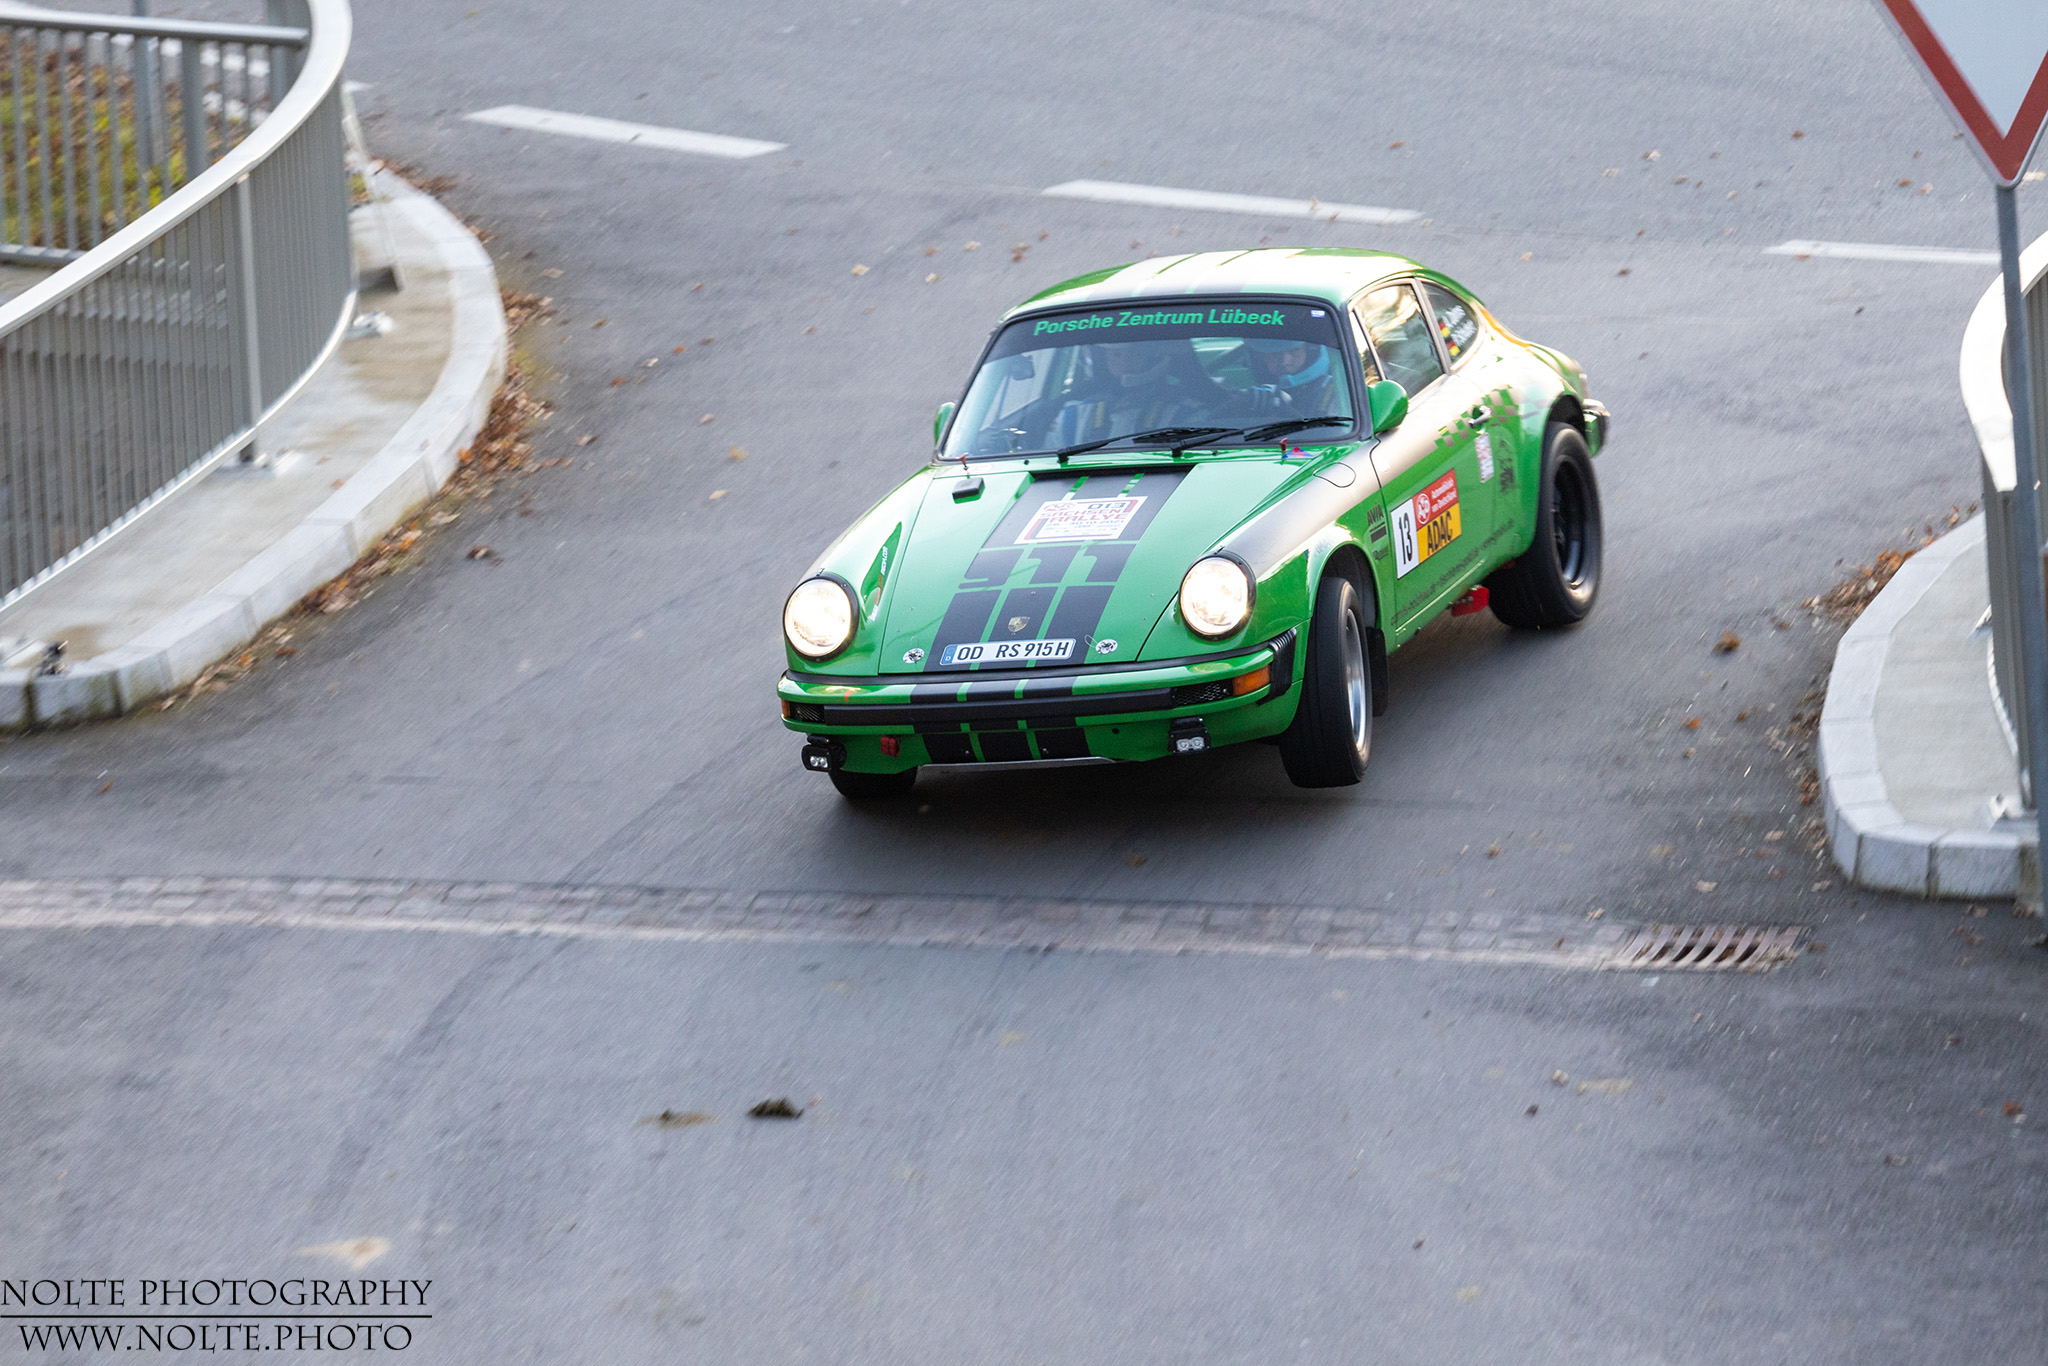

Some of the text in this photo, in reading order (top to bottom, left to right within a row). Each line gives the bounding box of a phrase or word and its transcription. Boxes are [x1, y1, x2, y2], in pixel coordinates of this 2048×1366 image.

[1033, 308, 1286, 336] Porsche Zentrum Lübeck
[1041, 508, 1124, 517] SACHSEN
[1049, 513, 1129, 523] RALLYE
[1398, 512, 1413, 566] 13
[1427, 510, 1454, 556] ADAC
[957, 646, 984, 661] OD
[995, 644, 1021, 659] RS
[1024, 642, 1069, 657] 915H
